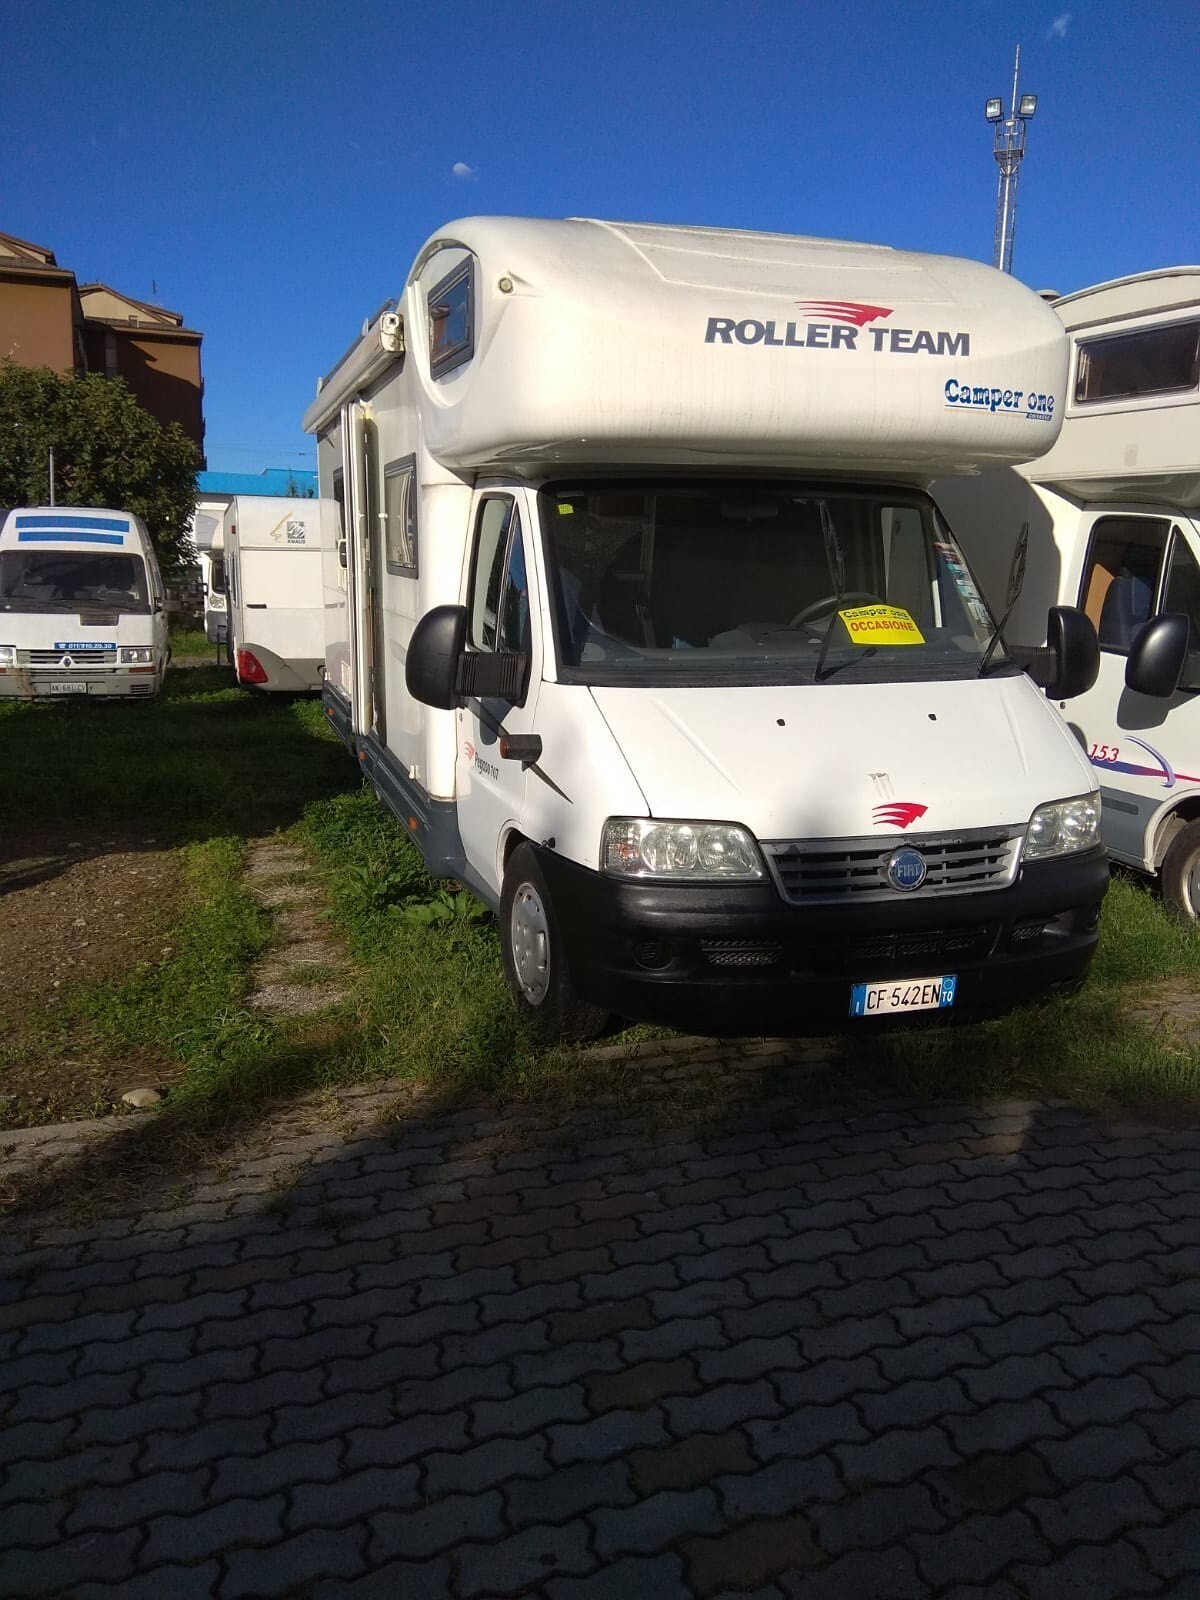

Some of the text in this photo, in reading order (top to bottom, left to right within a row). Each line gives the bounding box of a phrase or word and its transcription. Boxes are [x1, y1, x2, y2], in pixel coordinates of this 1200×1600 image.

[704, 317, 970, 357] ROLLER TEAM
[944, 378, 1055, 413] Camper one
[843, 608, 888, 618] Camper
[850, 620, 916, 632] OCCASIONE
[475, 751, 490, 775] Pegaso
[1090, 743, 1119, 762] 153
[897, 863, 921, 878] FIAT
[866, 990, 887, 1010] CF
[891, 984, 942, 1007] 542EN
[942, 991, 953, 1002] TO
